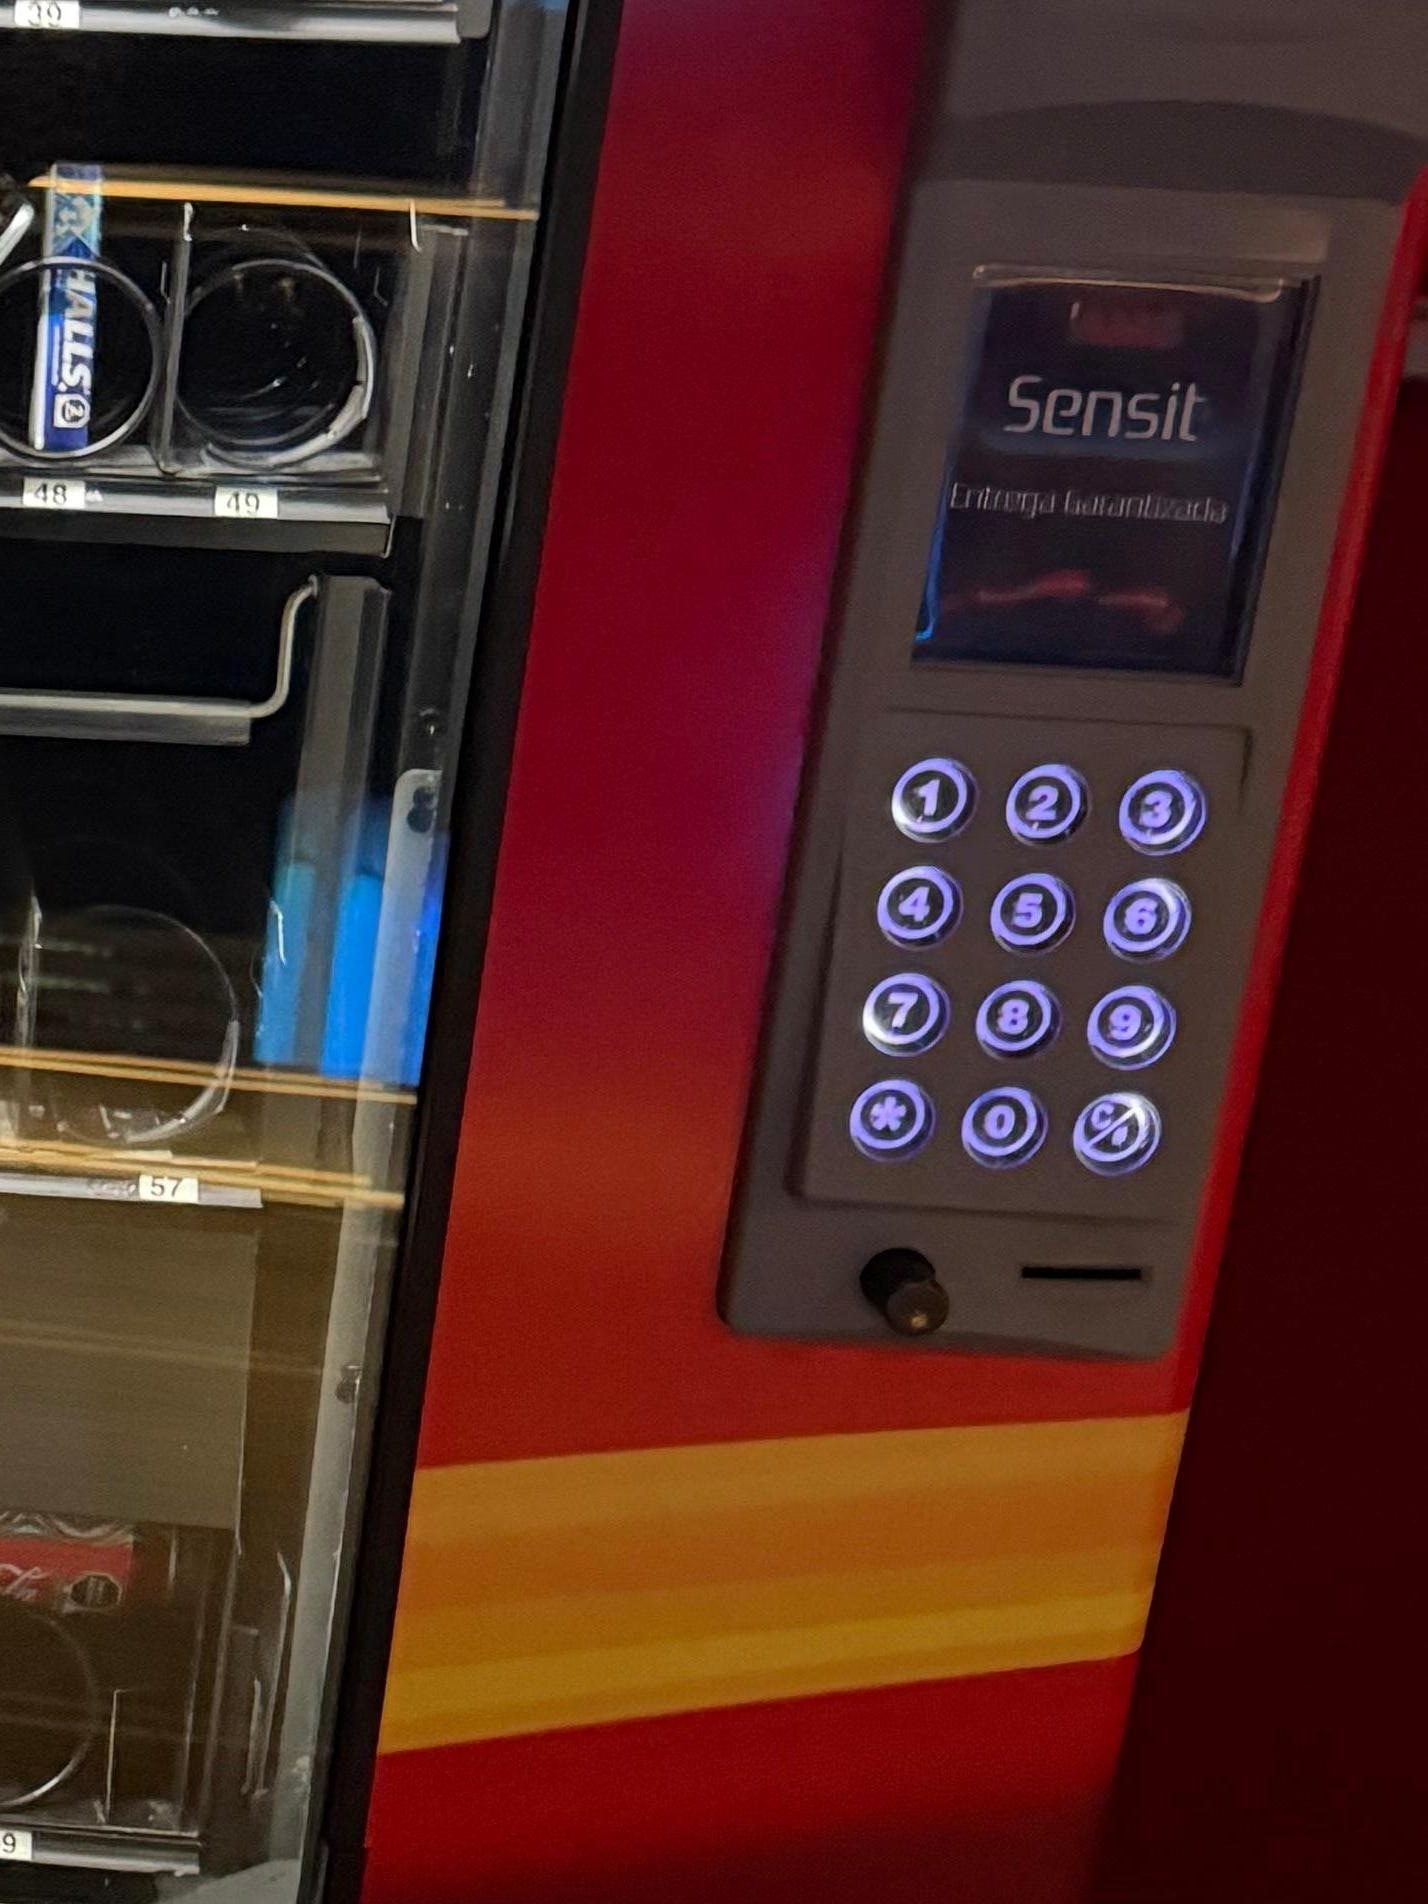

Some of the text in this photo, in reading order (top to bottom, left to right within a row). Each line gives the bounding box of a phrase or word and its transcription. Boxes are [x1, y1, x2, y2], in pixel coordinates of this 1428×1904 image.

[61, 268, 97, 392] HALLS
[1003, 374, 1209, 442] Sensit
[34, 482, 68, 504] 48
[226, 491, 260, 515] 49
[913, 779, 941, 816] 1
[1026, 785, 1059, 820] 2
[1139, 790, 1172, 828] 3
[898, 887, 931, 922] 4
[1012, 893, 1044, 928] 5
[1124, 898, 1158, 934] 6
[887, 992, 919, 1029] 7
[997, 999, 1030, 1034] 8
[1109, 1004, 1142, 1040] 9
[984, 1105, 1015, 1140] 0
[150, 1178, 181, 1197] 57
